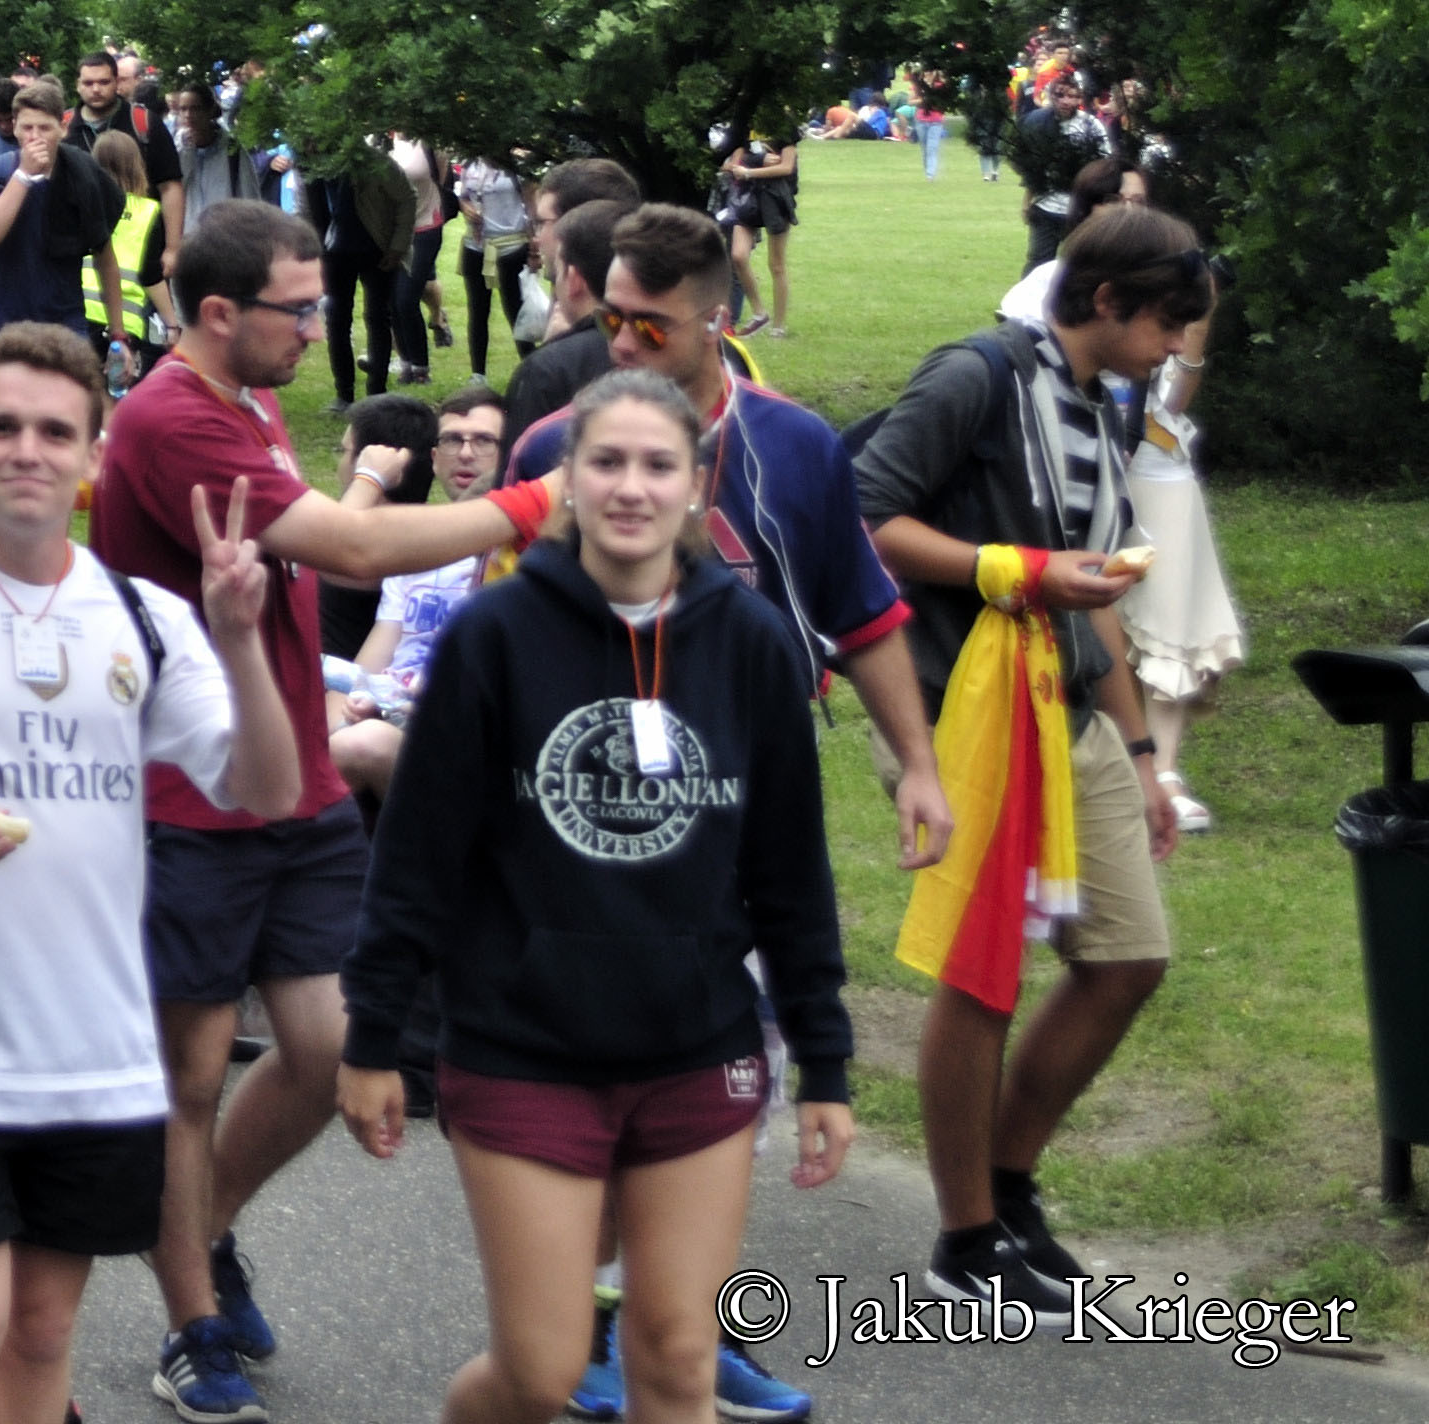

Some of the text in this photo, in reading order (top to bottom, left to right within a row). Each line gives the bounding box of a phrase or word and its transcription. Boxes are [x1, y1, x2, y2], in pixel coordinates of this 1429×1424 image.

[17, 711, 79, 751] Fly
[549, 724, 584, 766] ALMA
[556, 806, 689, 856] UNIVERSITY
